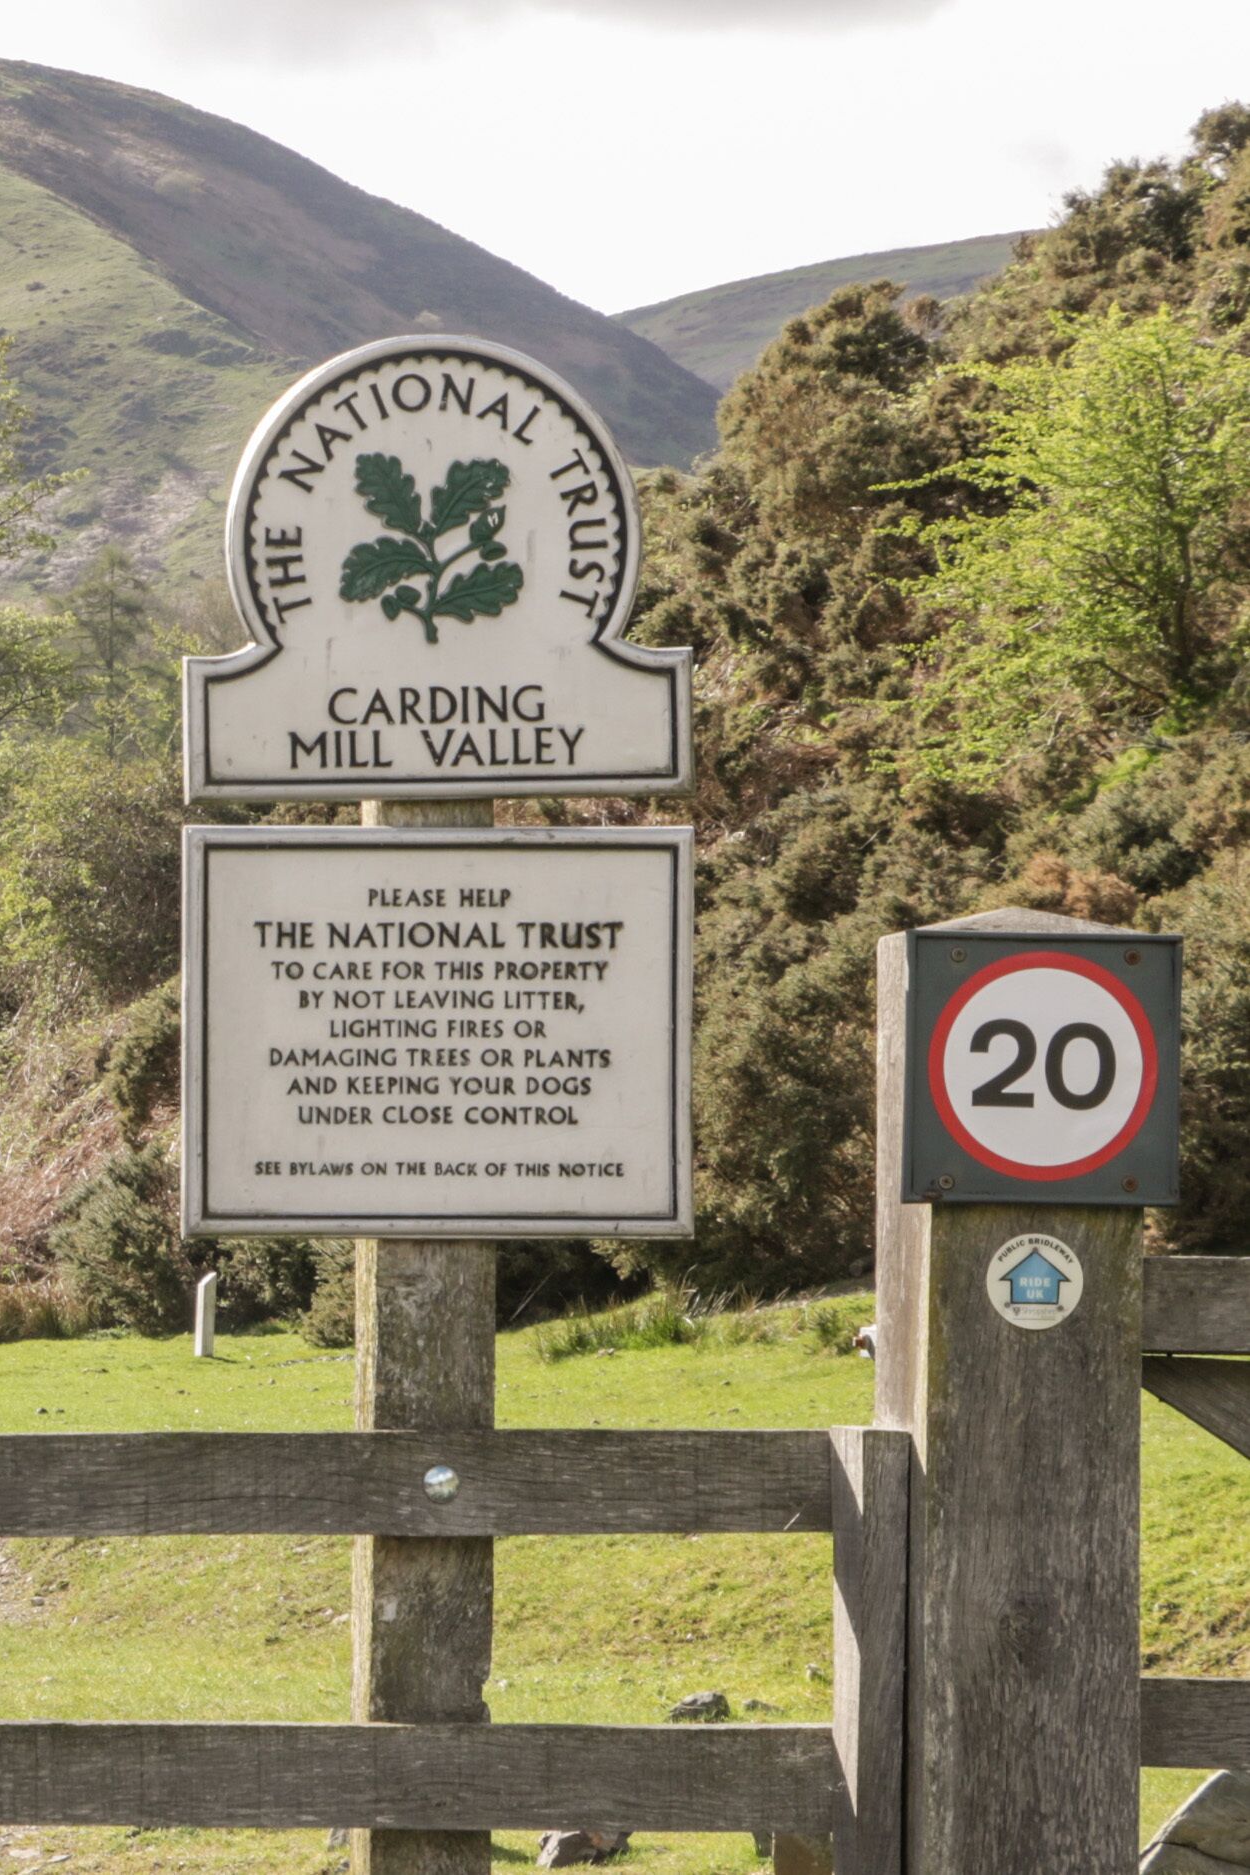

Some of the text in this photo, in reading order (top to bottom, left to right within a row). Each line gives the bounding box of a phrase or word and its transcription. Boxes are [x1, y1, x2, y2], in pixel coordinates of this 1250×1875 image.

[265, 373, 608, 624] THE NATIONAL TRUST
[327, 684, 545, 726] CARDING
[288, 727, 585, 770] MILL VALLEY
[368, 888, 512, 908] PLEASE HELP
[253, 921, 624, 950] THE NATIONAL TRUST
[271, 961, 609, 981] TO CARE FOR THIS PROPERTY
[299, 990, 585, 1013] BY NOT LEAVING LITTER,
[330, 1019, 547, 1039] LIGHTING FIRES OR
[269, 1047, 611, 1069] DAMAGING TREES OR PLANTS
[969, 1018, 1117, 1111] 20
[287, 1076, 591, 1096] AND KEEPING YOUR DOGS
[298, 1105, 579, 1126] UNDER CLOSE CONTROL
[254, 1161, 624, 1178] SEE BYLAWS ON THE BACK OF THIS NOTICE
[998, 1238, 1073, 1263] PUBLIC BRIDLEWAY
[1020, 1277, 1051, 1287] RIDE
[1027, 1289, 1044, 1299] UK
